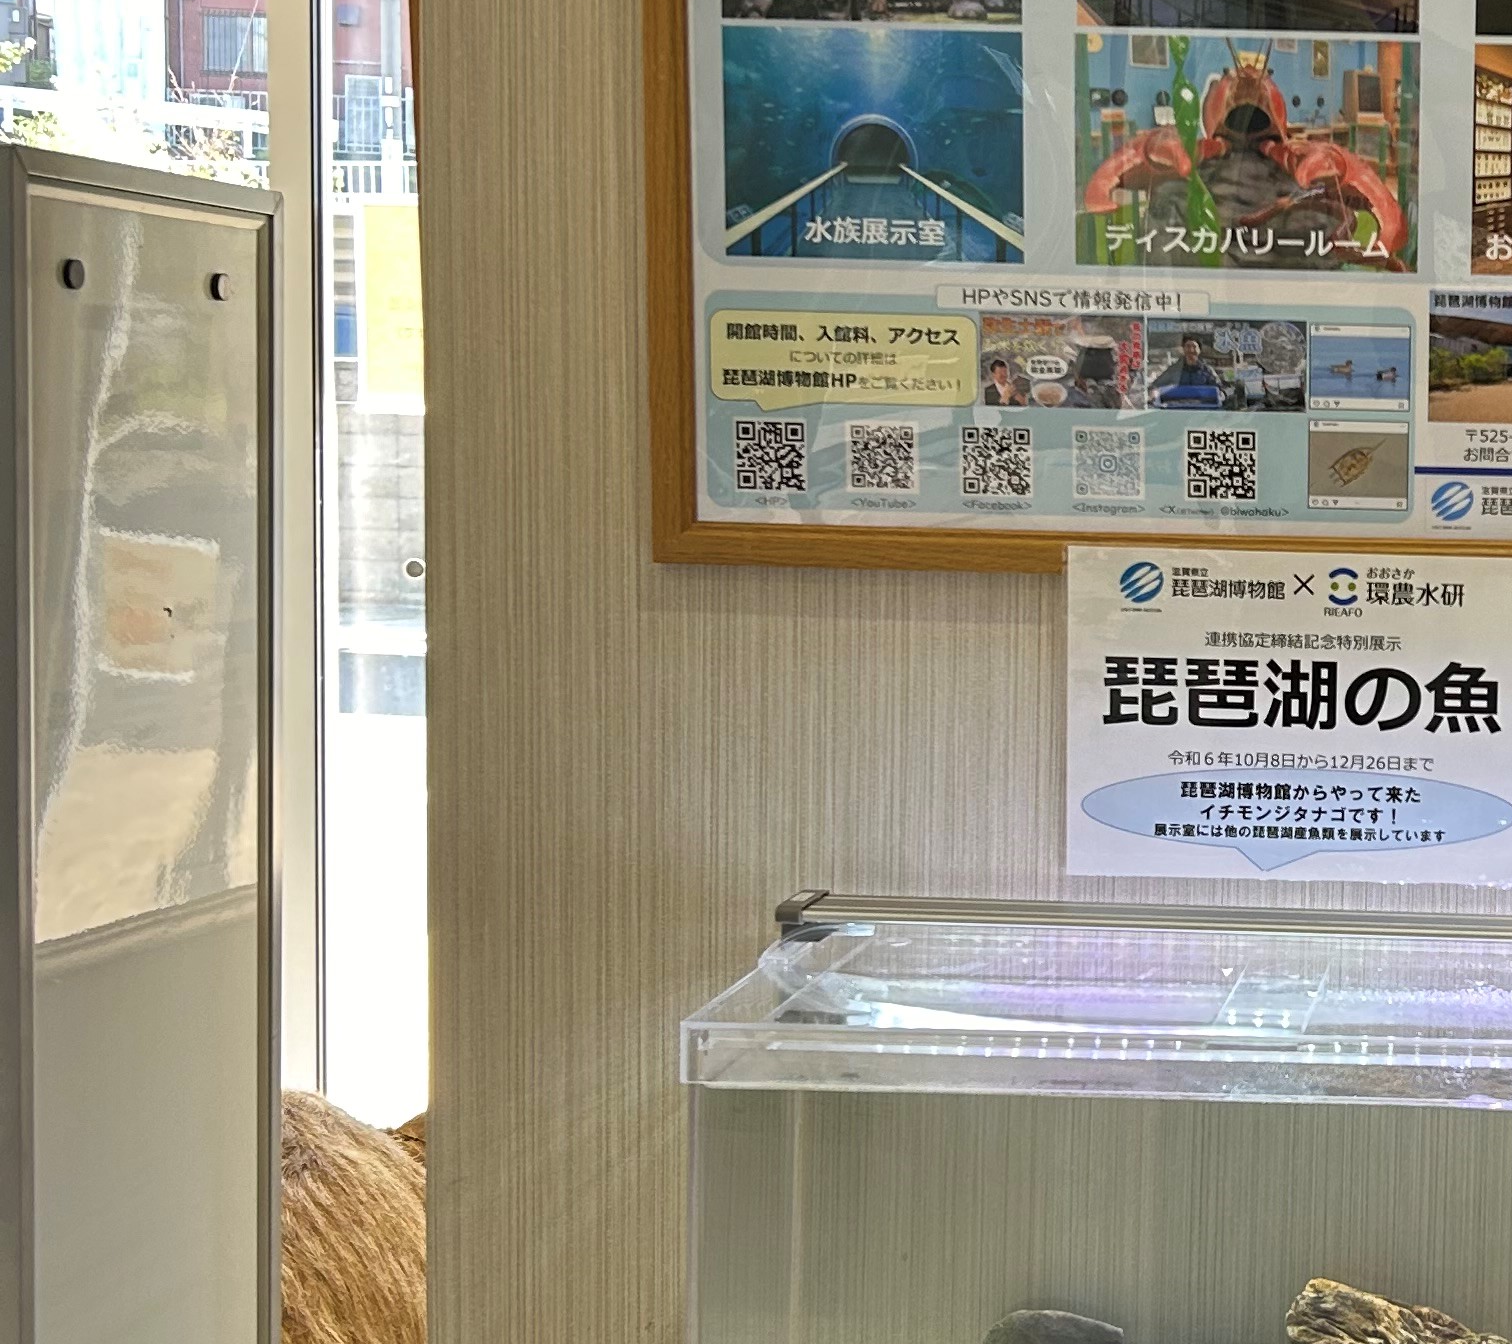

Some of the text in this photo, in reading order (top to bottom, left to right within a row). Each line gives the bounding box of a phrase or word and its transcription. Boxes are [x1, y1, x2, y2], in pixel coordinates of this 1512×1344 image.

[804, 217, 946, 247] 水族展示室
[1106, 226, 1390, 260] ディスカバリールーム
[726, 323, 961, 346] 開館時間、入館料、アクセス
[1366, 566, 1416, 579] おおさか
[1171, 578, 1286, 600] 琵琶湖博物館
[1365, 581, 1465, 608] 環農水研
[1204, 631, 1402, 652] 連携協定締結記念特別展示
[1102, 655, 1502, 734] 琵琶湖の魚
[1180, 781, 1421, 803] 琵琶湖博物館からやって来た
[1199, 805, 1398, 824] イチモンジタナゴです！
